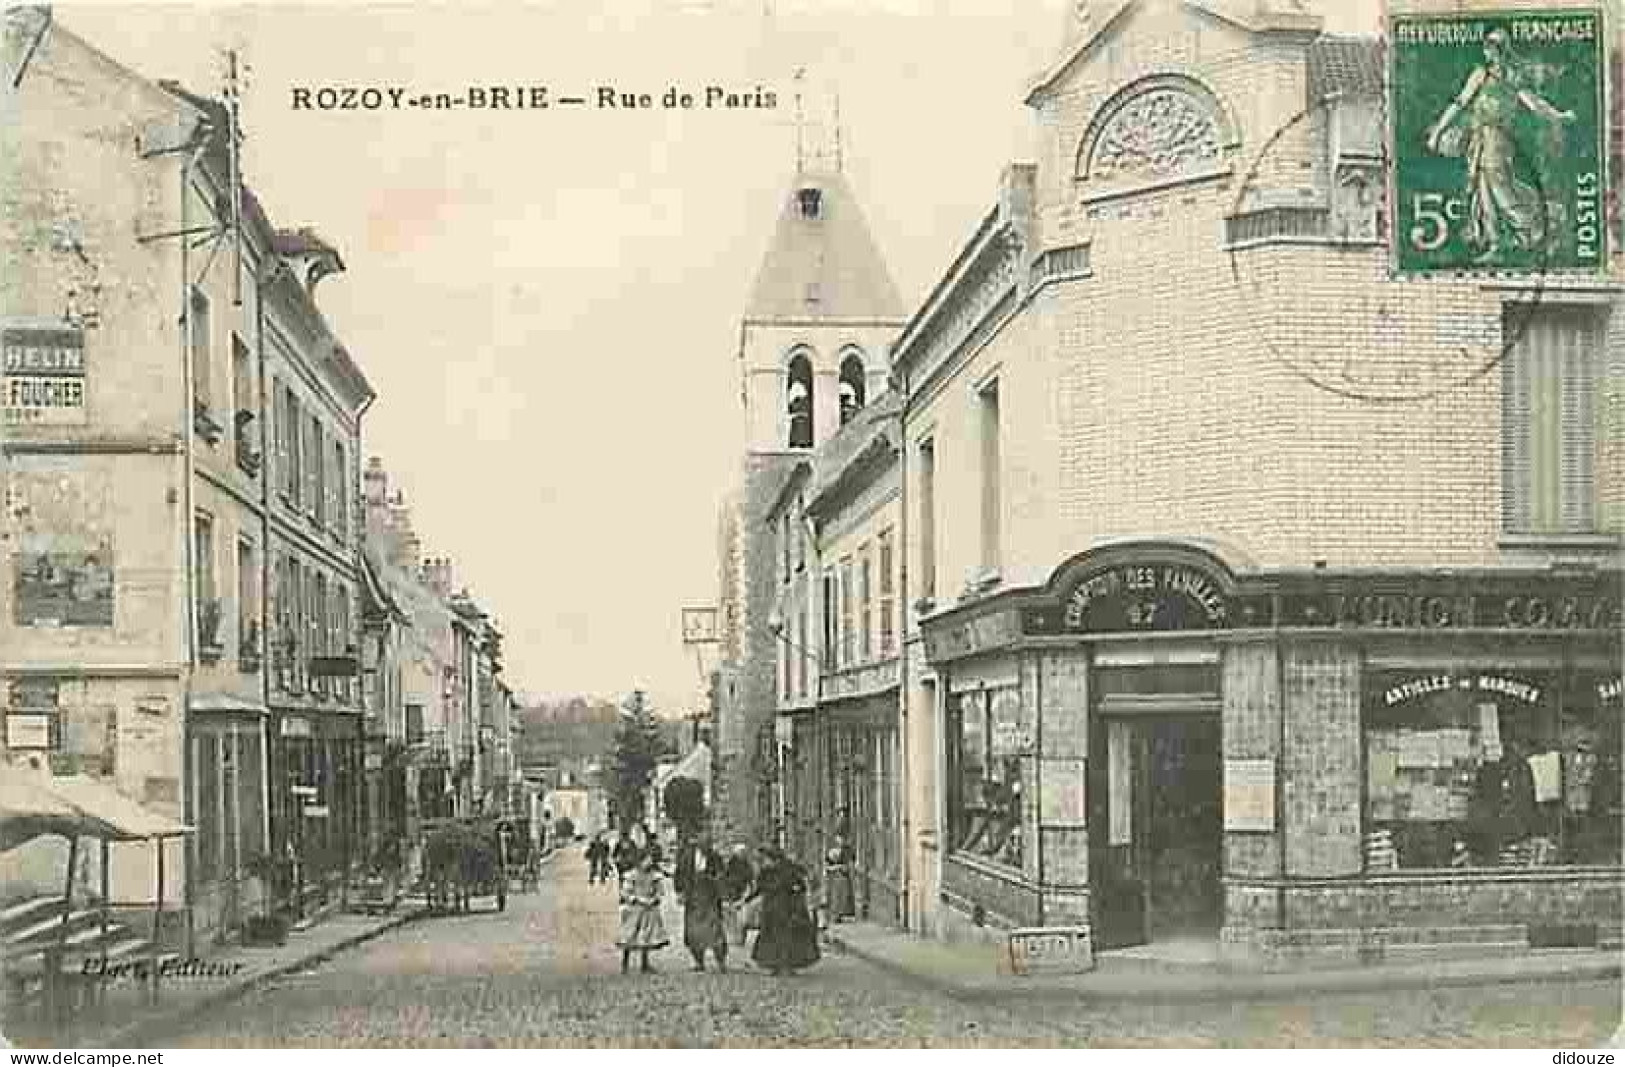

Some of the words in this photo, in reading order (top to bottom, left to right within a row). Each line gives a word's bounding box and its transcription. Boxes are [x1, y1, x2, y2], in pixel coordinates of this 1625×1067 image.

[291, 87, 549, 109] ROZOY-en-BRIE
[597, 86, 653, 109] Rue
[662, 87, 693, 109] de
[705, 86, 777, 109] Paris
[1577, 172, 1598, 258] POSTES
[11, 380, 82, 407] FOUCHER
